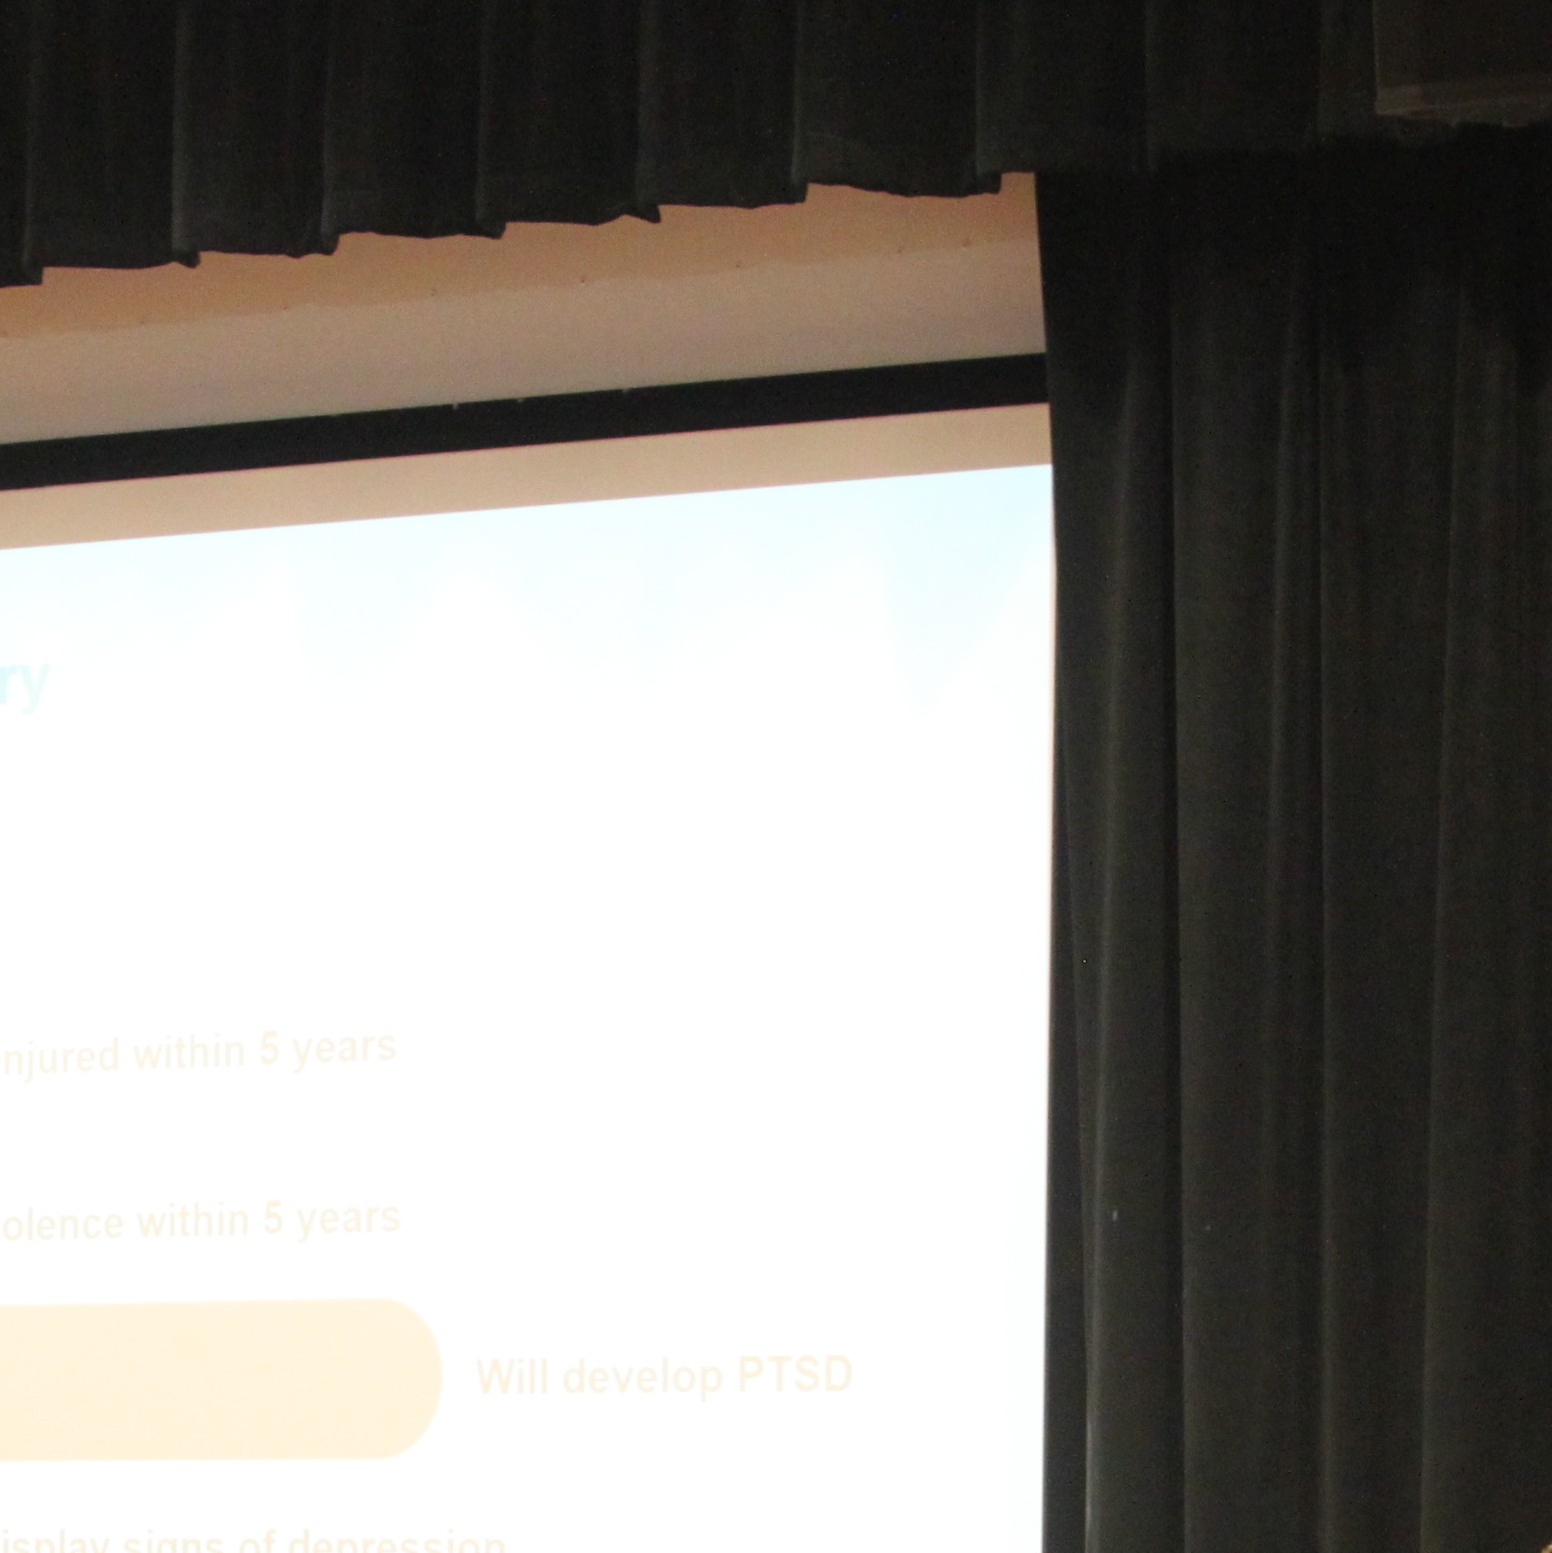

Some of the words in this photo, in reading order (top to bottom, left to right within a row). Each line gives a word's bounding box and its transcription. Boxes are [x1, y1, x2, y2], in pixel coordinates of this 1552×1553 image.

[134, 1033, 246, 1070] within
[260, 1031, 280, 1065] 5
[294, 1032, 398, 1073] years
[137, 1202, 249, 1238] within
[264, 1201, 284, 1234] 5
[298, 1203, 402, 1242] years
[477, 1358, 548, 1395] Will
[562, 1358, 724, 1402] develop
[739, 1356, 854, 1392] PTSD
